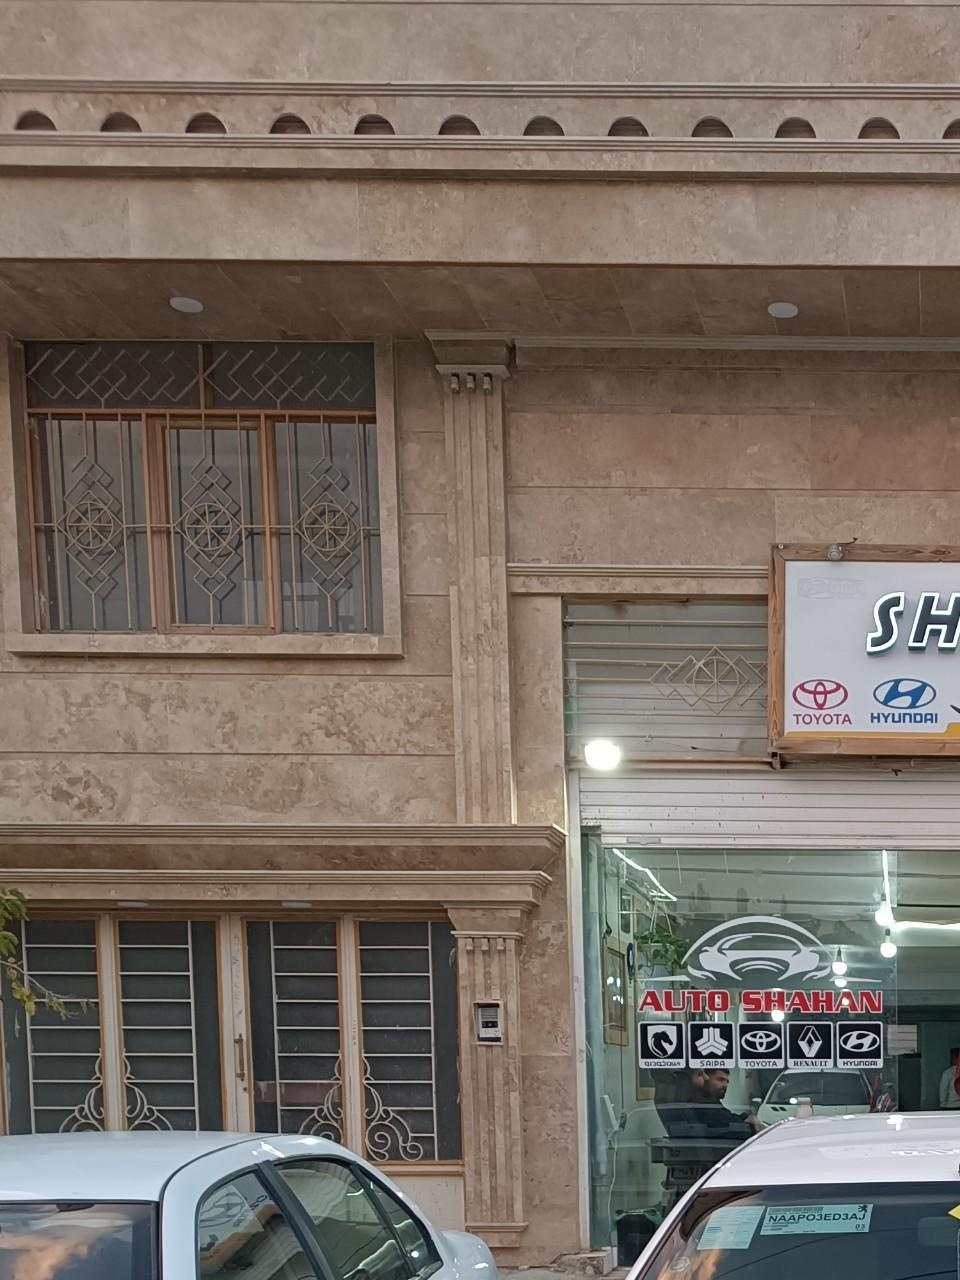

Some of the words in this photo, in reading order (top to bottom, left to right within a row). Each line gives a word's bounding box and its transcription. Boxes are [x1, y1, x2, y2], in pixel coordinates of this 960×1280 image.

[793, 713, 852, 725] TOYOTA
[870, 712, 938, 724] HYUNDAI
[638, 989, 730, 1013] AUTO
[741, 989, 883, 1014] SHAHAN
